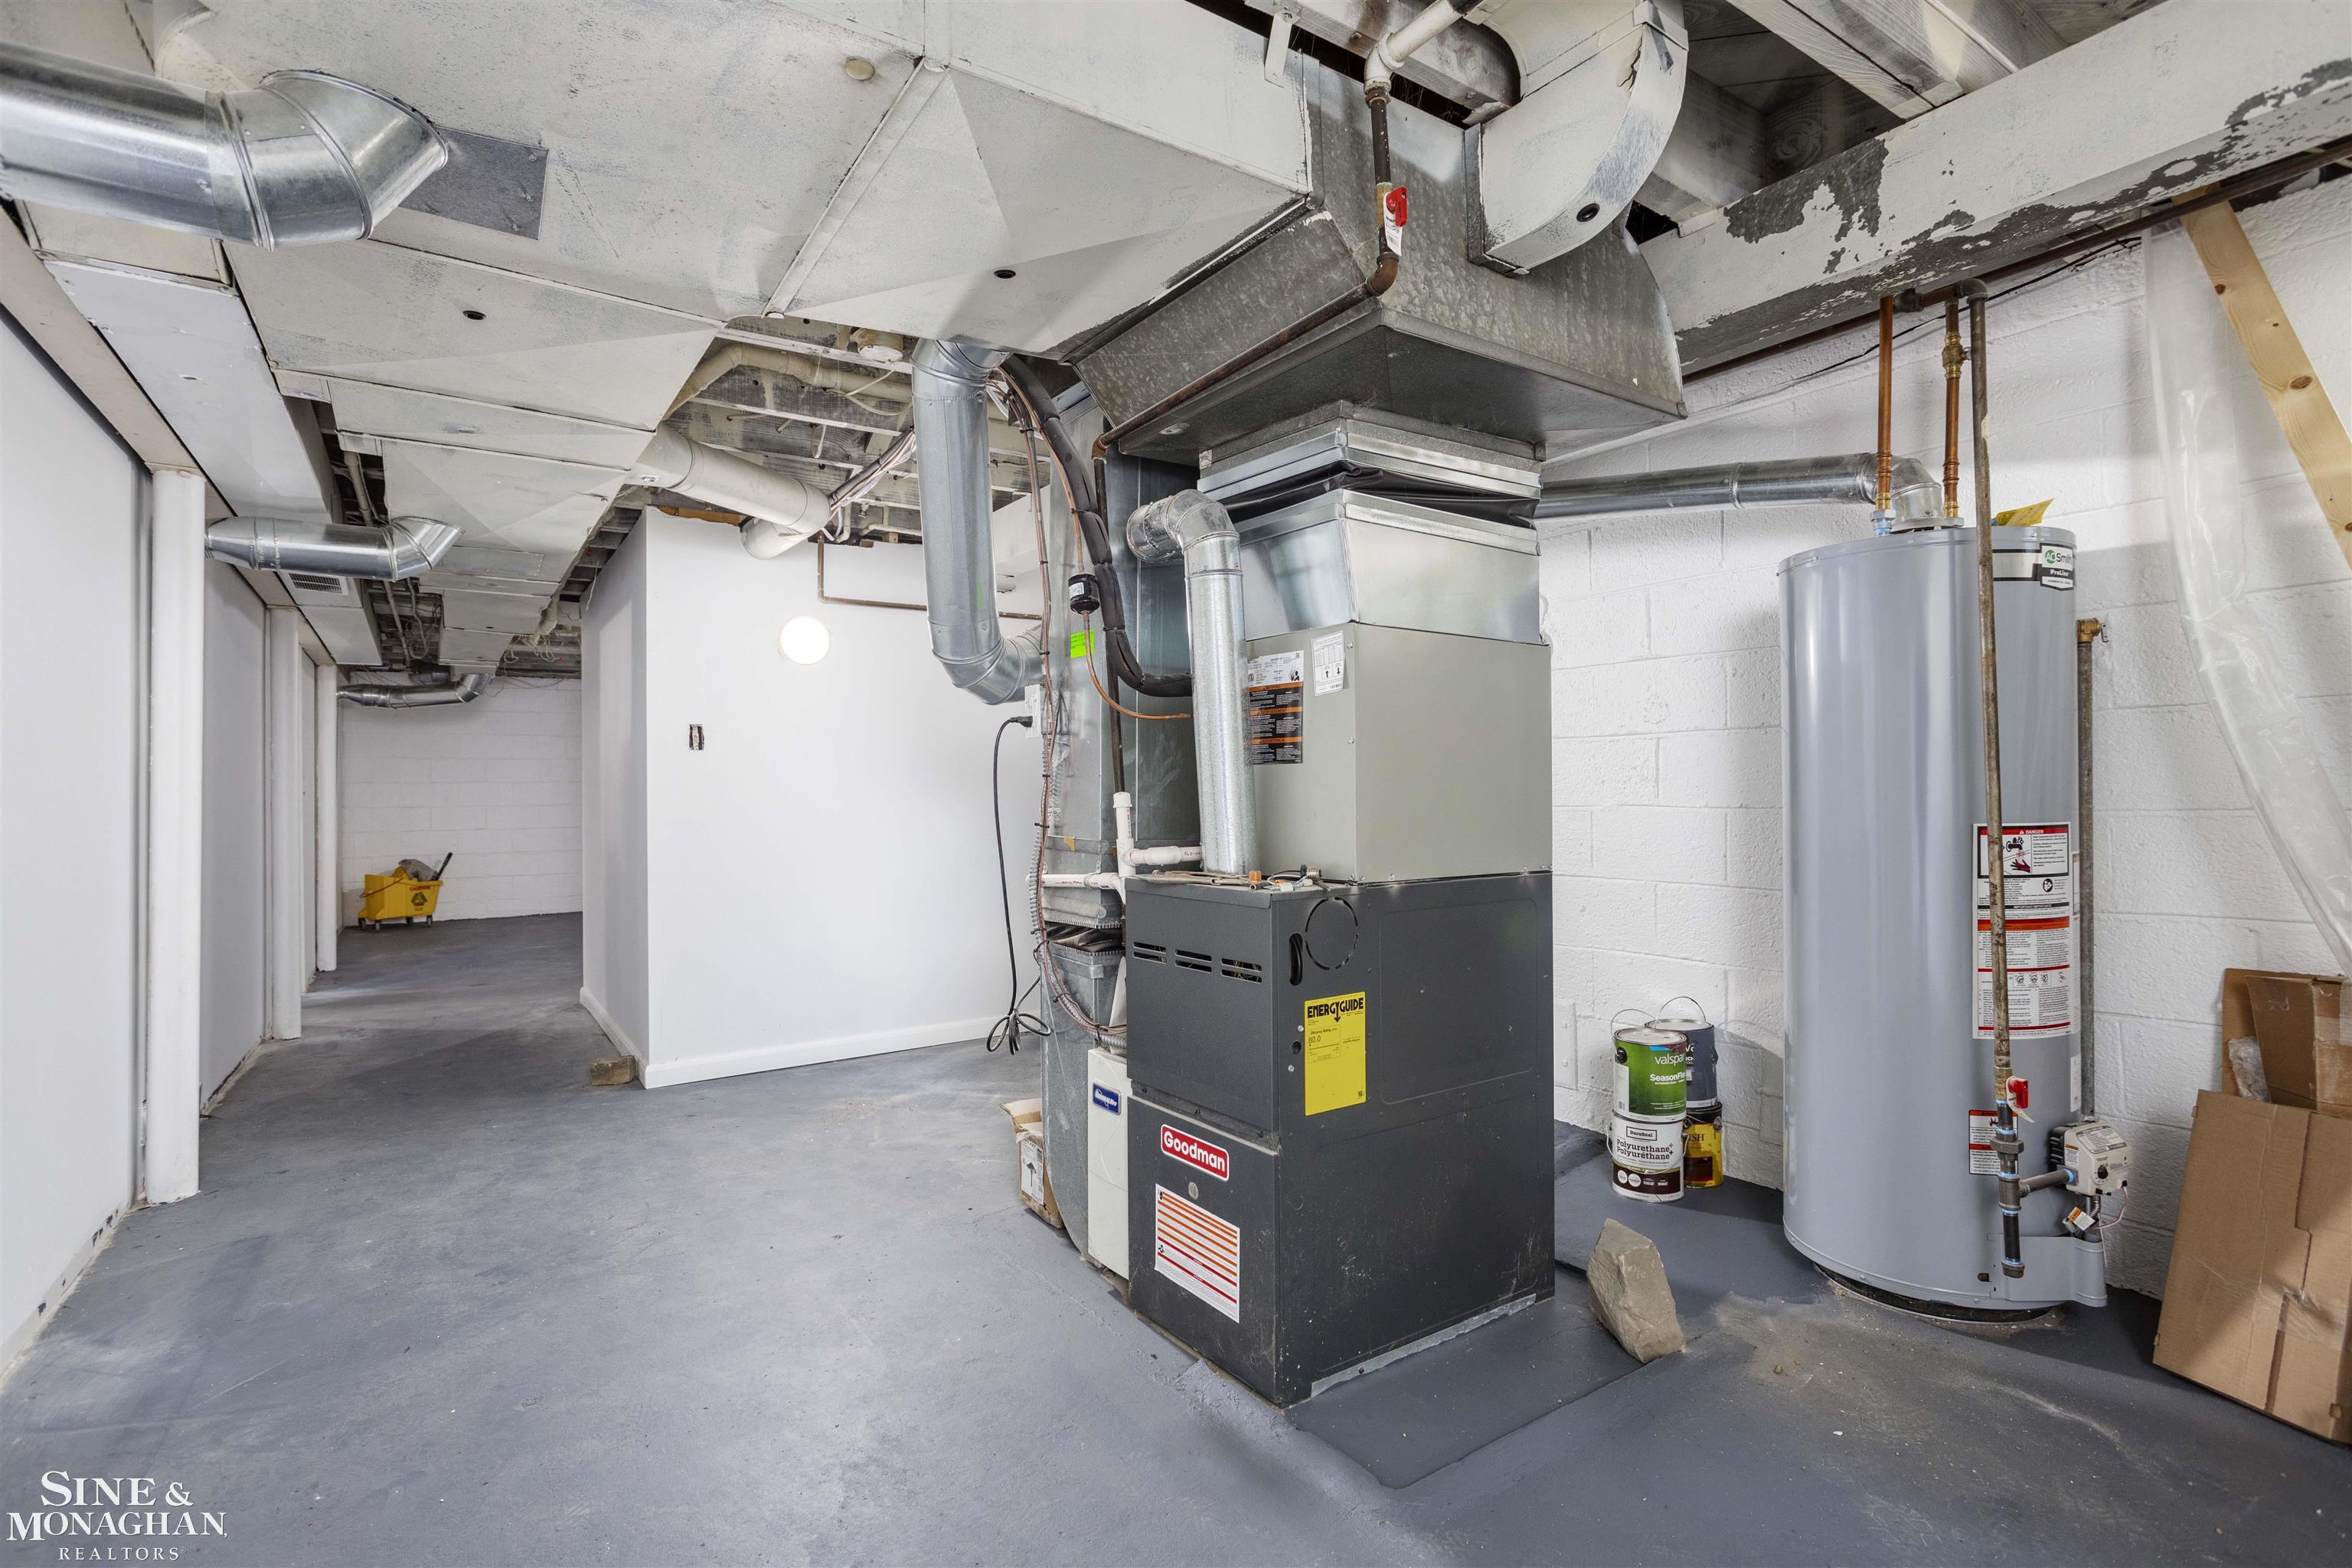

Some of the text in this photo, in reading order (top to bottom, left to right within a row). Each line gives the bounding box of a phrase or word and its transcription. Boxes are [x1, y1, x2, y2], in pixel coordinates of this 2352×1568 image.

[1307, 997, 1364, 1021] ENERGYGUIDE
[1308, 1034, 1321, 1044] 80.0
[1655, 1053, 1685, 1066] valspar
[1629, 1129, 1653, 1138] DuraSeal
[1689, 1133, 1704, 1142] ISH
[1164, 1131, 1225, 1172] Goodman
